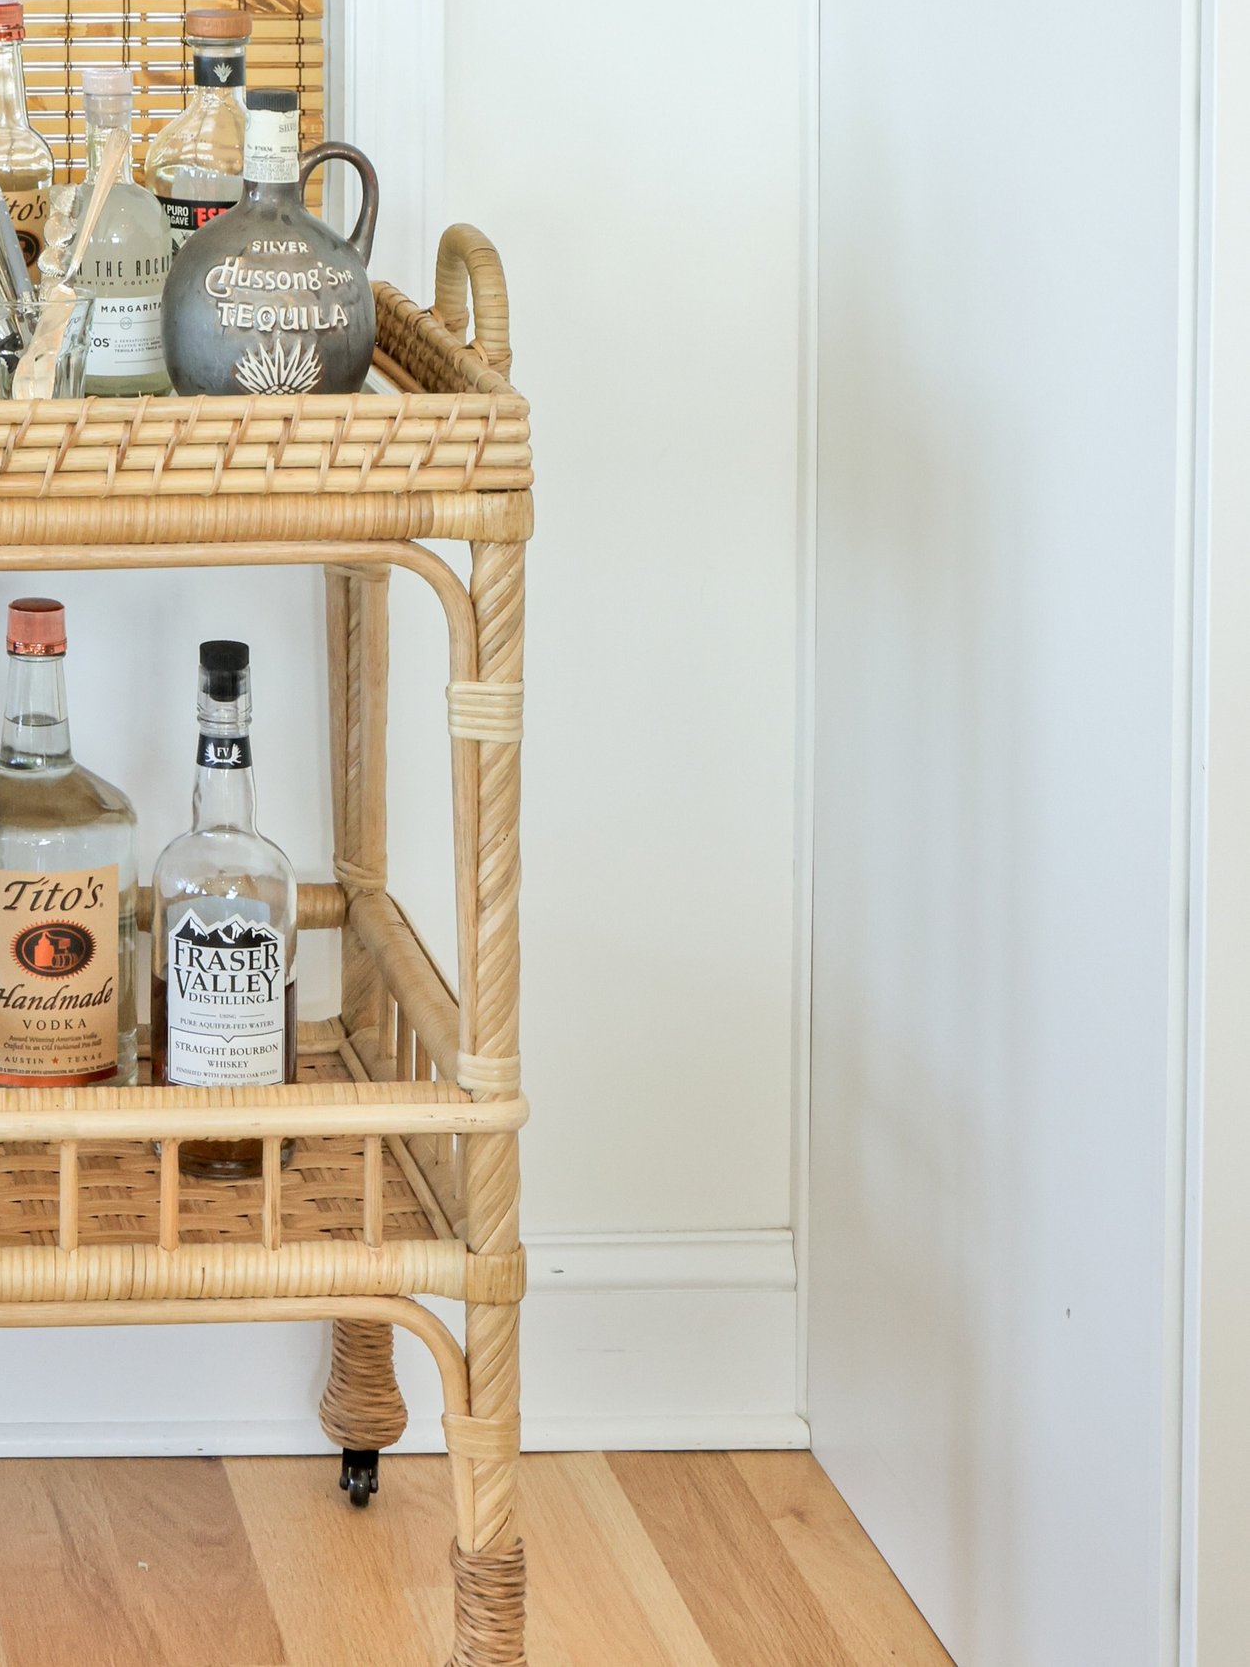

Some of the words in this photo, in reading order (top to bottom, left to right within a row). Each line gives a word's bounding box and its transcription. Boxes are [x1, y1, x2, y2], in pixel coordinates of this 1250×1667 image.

[3, 195, 47, 221] to's
[167, 204, 189, 217] PURO
[252, 240, 309, 254] SILVER
[95, 260, 123, 277] THE
[217, 303, 349, 333] TEQUILA
[217, 747, 229, 757] FV
[2, 876, 104, 912] Tito's
[174, 938, 280, 973] FRASER
[174, 967, 280, 1003] VALLEY
[189, 992, 265, 1005] DISTILLING
[22, 1018, 87, 1031] VODKA
[180, 1017, 197, 1026] PURE
[249, 1020, 275, 1029] WATERS
[175, 1041, 227, 1056] STRAIGHT
[230, 1043, 279, 1056] BOURBON
[4, 1056, 44, 1065] AUSTIN
[67, 1052, 102, 1063] TEXAS
[207, 1060, 250, 1069] WHISKEY
[203, 1071, 220, 1079] WITH
